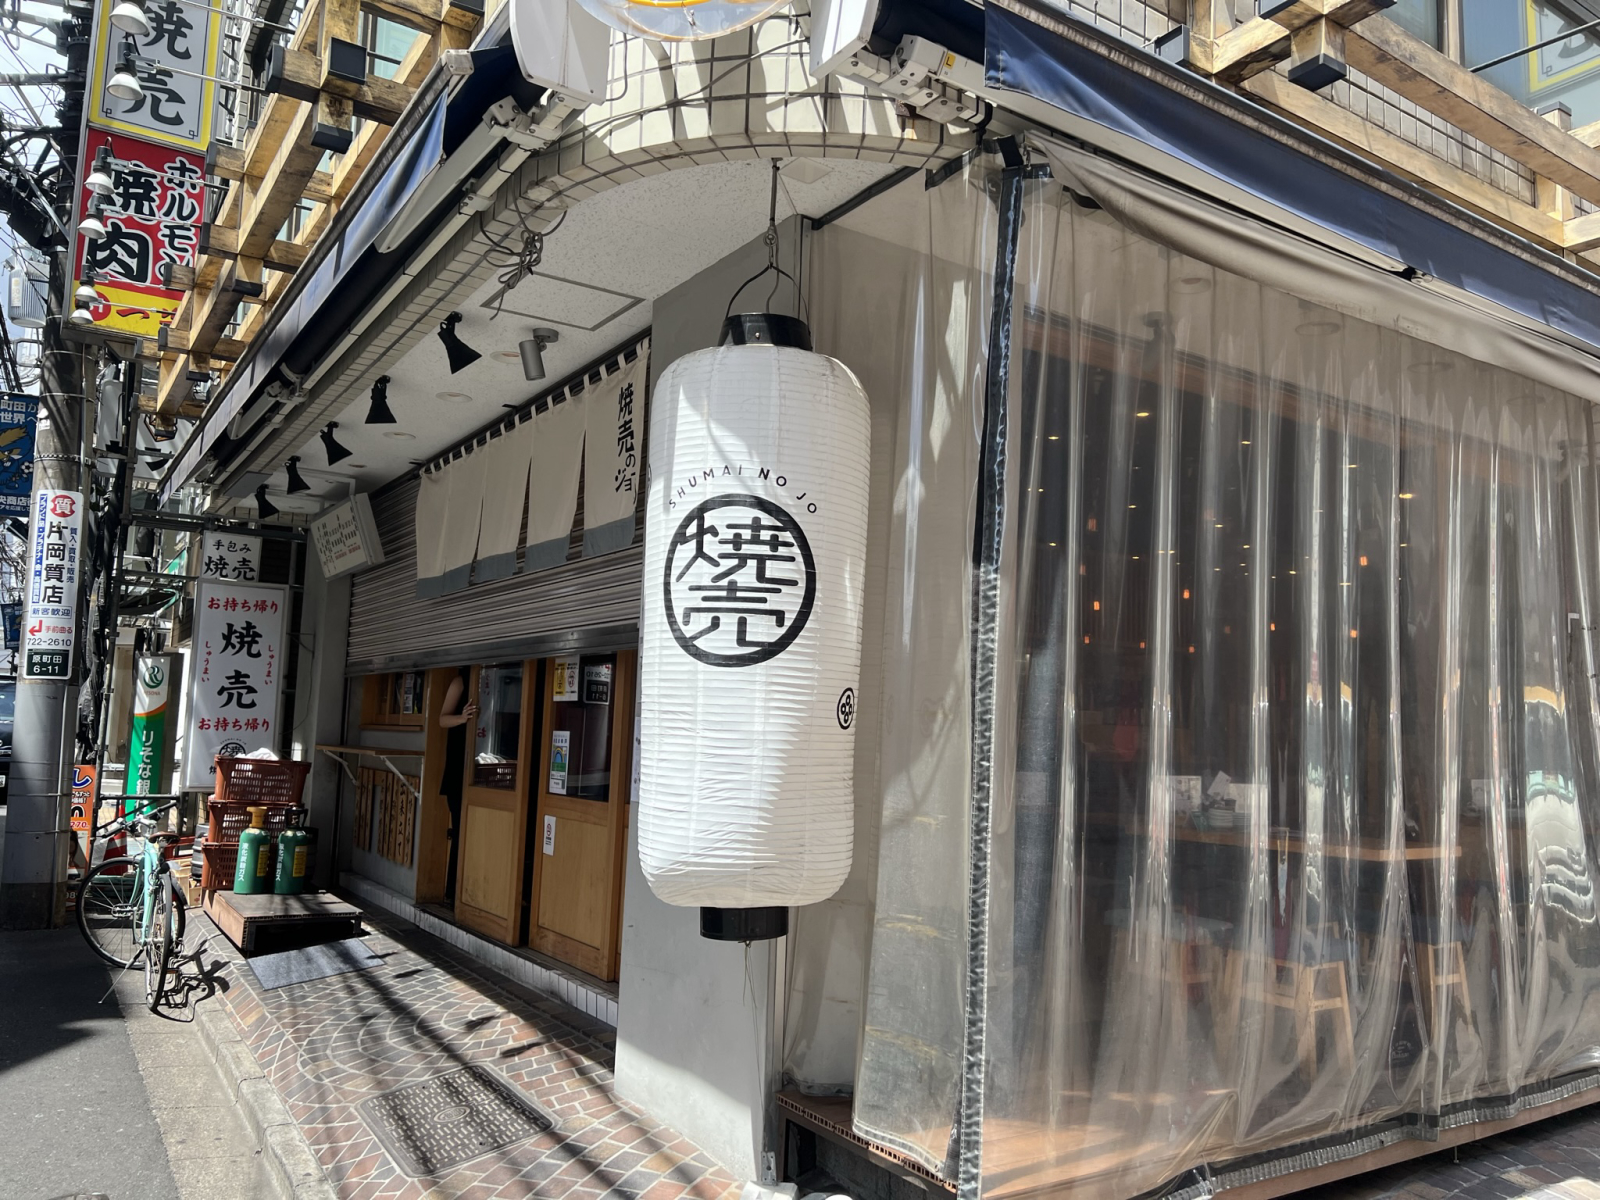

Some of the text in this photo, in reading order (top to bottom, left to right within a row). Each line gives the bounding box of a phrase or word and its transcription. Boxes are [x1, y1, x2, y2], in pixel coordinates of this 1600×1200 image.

[668, 464, 817, 514] SHUMAI NO JO
[212, 539, 252, 553] 手包み
[42, 520, 69, 604] 片岡質店
[203, 555, 256, 582] 焼売
[207, 597, 279, 615] お持ち帰り
[27, 637, 72, 647] 722-2610
[32, 655, 63, 664] 原町田
[33, 665, 60, 674] 6-11
[200, 640, 213, 683] しゅうまい
[216, 620, 264, 710] 焼売
[264, 644, 276, 686] しゅうまい
[198, 716, 270, 732] お持ち帰り
